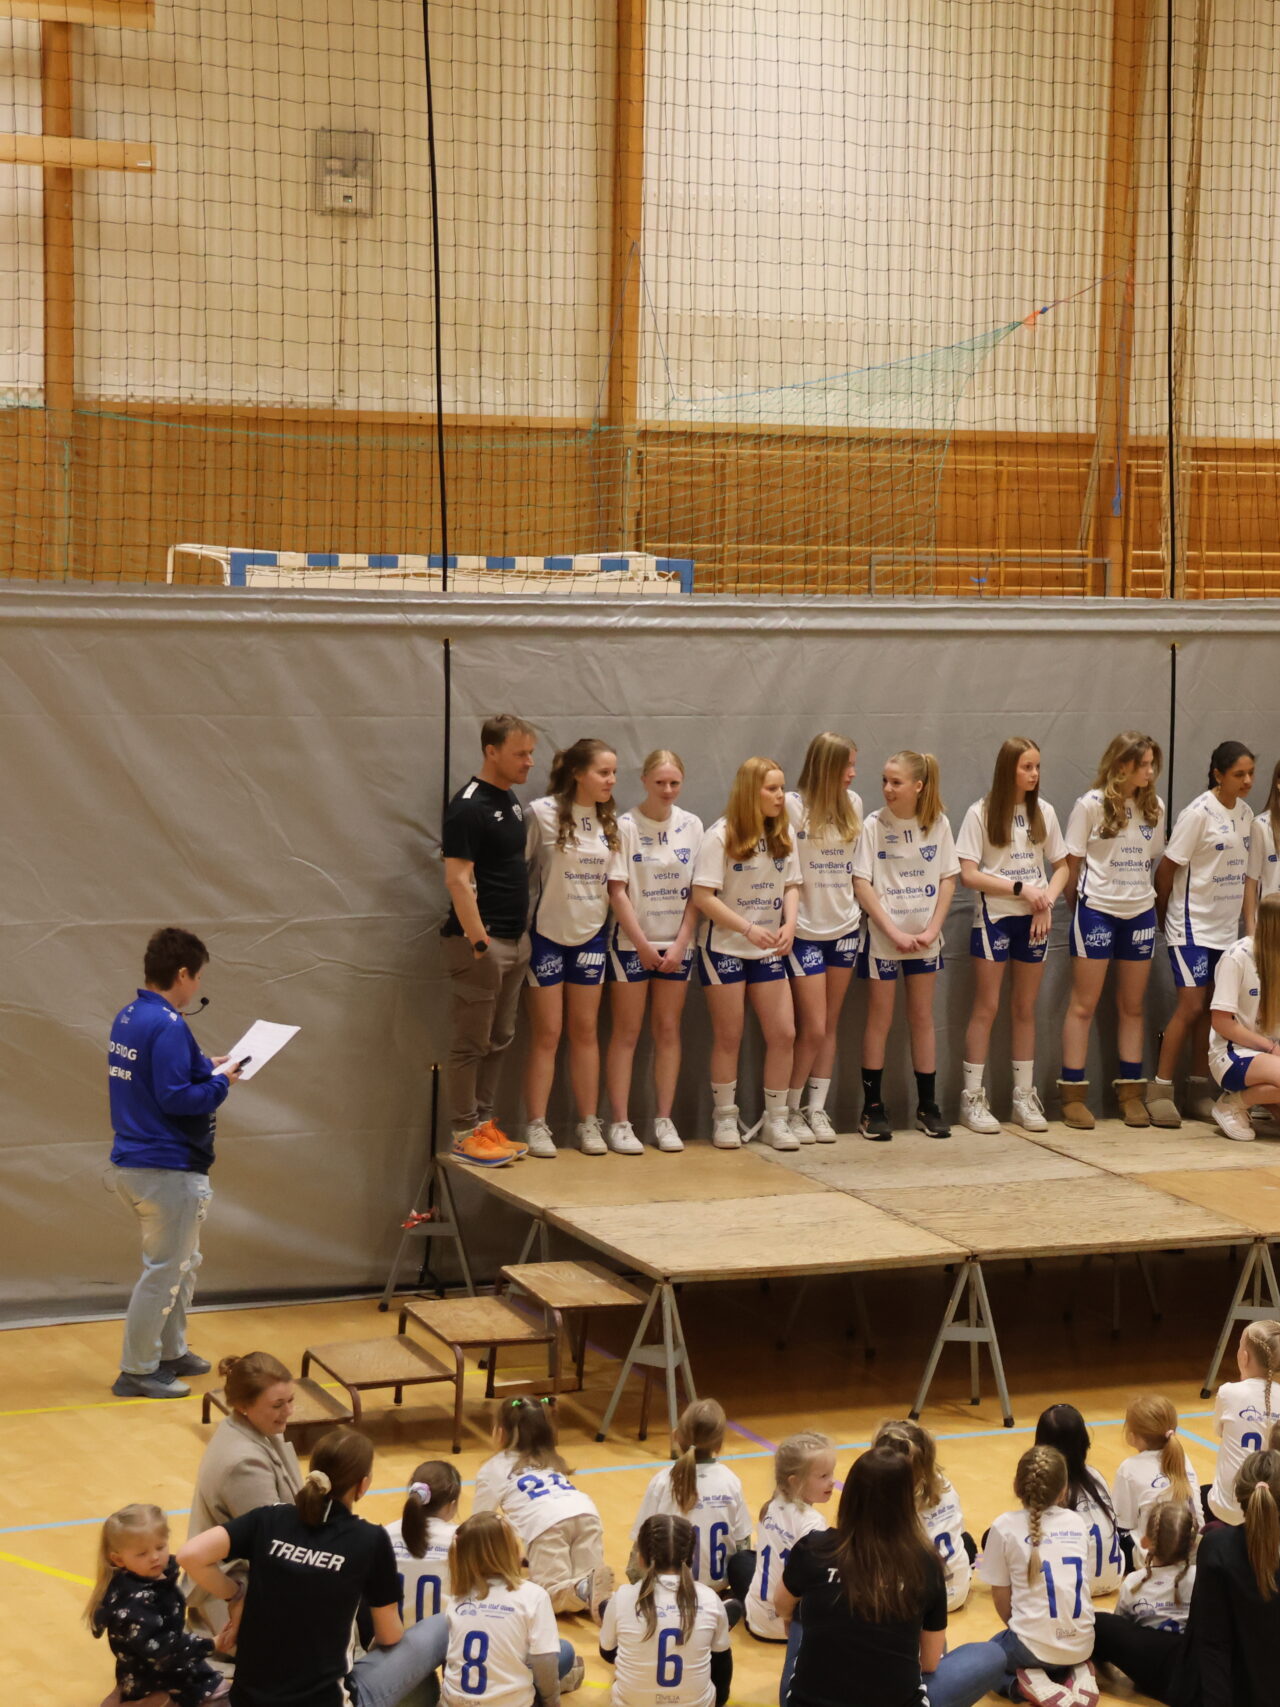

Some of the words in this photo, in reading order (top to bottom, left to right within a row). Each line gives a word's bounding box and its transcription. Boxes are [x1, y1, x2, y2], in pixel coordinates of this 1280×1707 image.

[581, 817, 592, 832] 15
[1014, 814, 1024, 827] 10
[658, 831, 669, 846] 14
[903, 830, 913, 844] 11
[820, 848, 844, 856] vestre
[1010, 851, 1034, 859] vestre
[1120, 846, 1143, 854] vestre
[579, 857, 605, 865] vestre
[809, 861, 846, 870] SpareBank
[1110, 860, 1144, 868] SpareBank
[564, 871, 601, 882] SpareBank
[654, 872, 680, 880] vestre
[899, 870, 925, 878] vestre
[1000, 868, 1036, 877] SpareBank
[750, 882, 774, 890] vestre
[886, 886, 924, 896] SpareBank
[642, 888, 678, 898] SpareBank
[736, 898, 772, 908] SpareBank
[270, 1538, 346, 1572] TRENER
[1090, 1522, 1122, 1578] 14
[1040, 1556, 1083, 1619] 17
[460, 1630, 490, 1696] 8
[656, 1628, 684, 1688] 6
